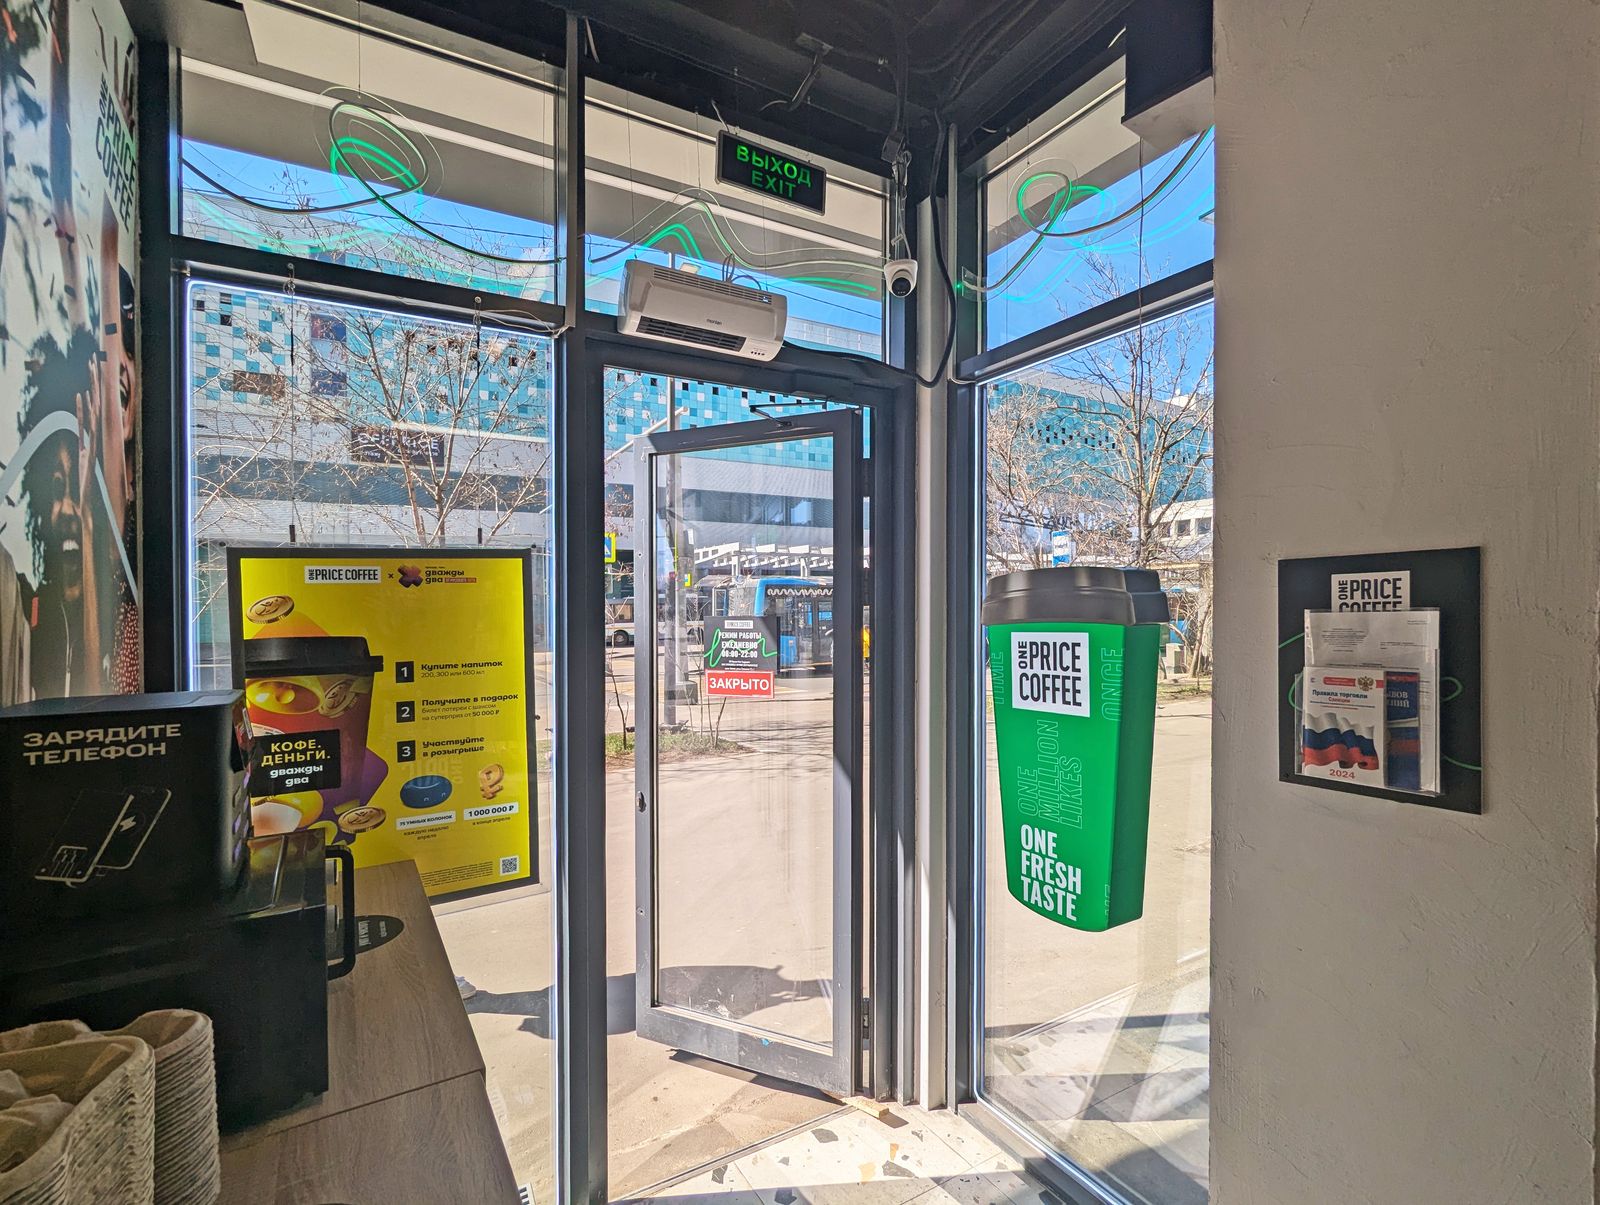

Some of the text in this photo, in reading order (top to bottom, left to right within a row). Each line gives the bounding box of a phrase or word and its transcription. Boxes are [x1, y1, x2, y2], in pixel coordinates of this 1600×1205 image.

[100, 72, 136, 197] ONE PRICE
[96, 116, 132, 233] COFFEE
[736, 144, 812, 188] ВЫХОД
[752, 170, 796, 198] EXIT
[315, 568, 343, 580] PRICE
[345, 568, 378, 580] COFFEE
[1338, 578, 1402, 600] ONE PRICE
[1018, 641, 1081, 673] ONE PRICE
[401, 667, 408, 677] 1
[709, 678, 769, 690] ЗАКРЫТО
[1020, 672, 1082, 707] COFFEE
[1101, 648, 1124, 721] ONCE
[422, 697, 470, 706] Получите
[481, 694, 518, 703] подарок
[401, 707, 410, 718] 2
[23, 724, 181, 747] ЗАРЯДИТЕ
[271, 739, 321, 752] КОФЕ.
[423, 736, 484, 748] Участвуйте
[23, 742, 166, 766] ТЕЛЕФОН
[261, 750, 330, 767] ДЕНЬГИ.
[402, 746, 411, 757] 3
[431, 746, 484, 757] розыгрыше
[270, 765, 323, 778] дважды
[285, 777, 309, 787] два
[1037, 720, 1060, 823] MILLION
[1330, 769, 1355, 779] 2024
[1018, 766, 1038, 816] ONE
[1059, 755, 1082, 829] LIKES
[1020, 824, 1058, 859] ONE
[1021, 850, 1081, 895] FRESH
[1021, 876, 1077, 922] TASTE
